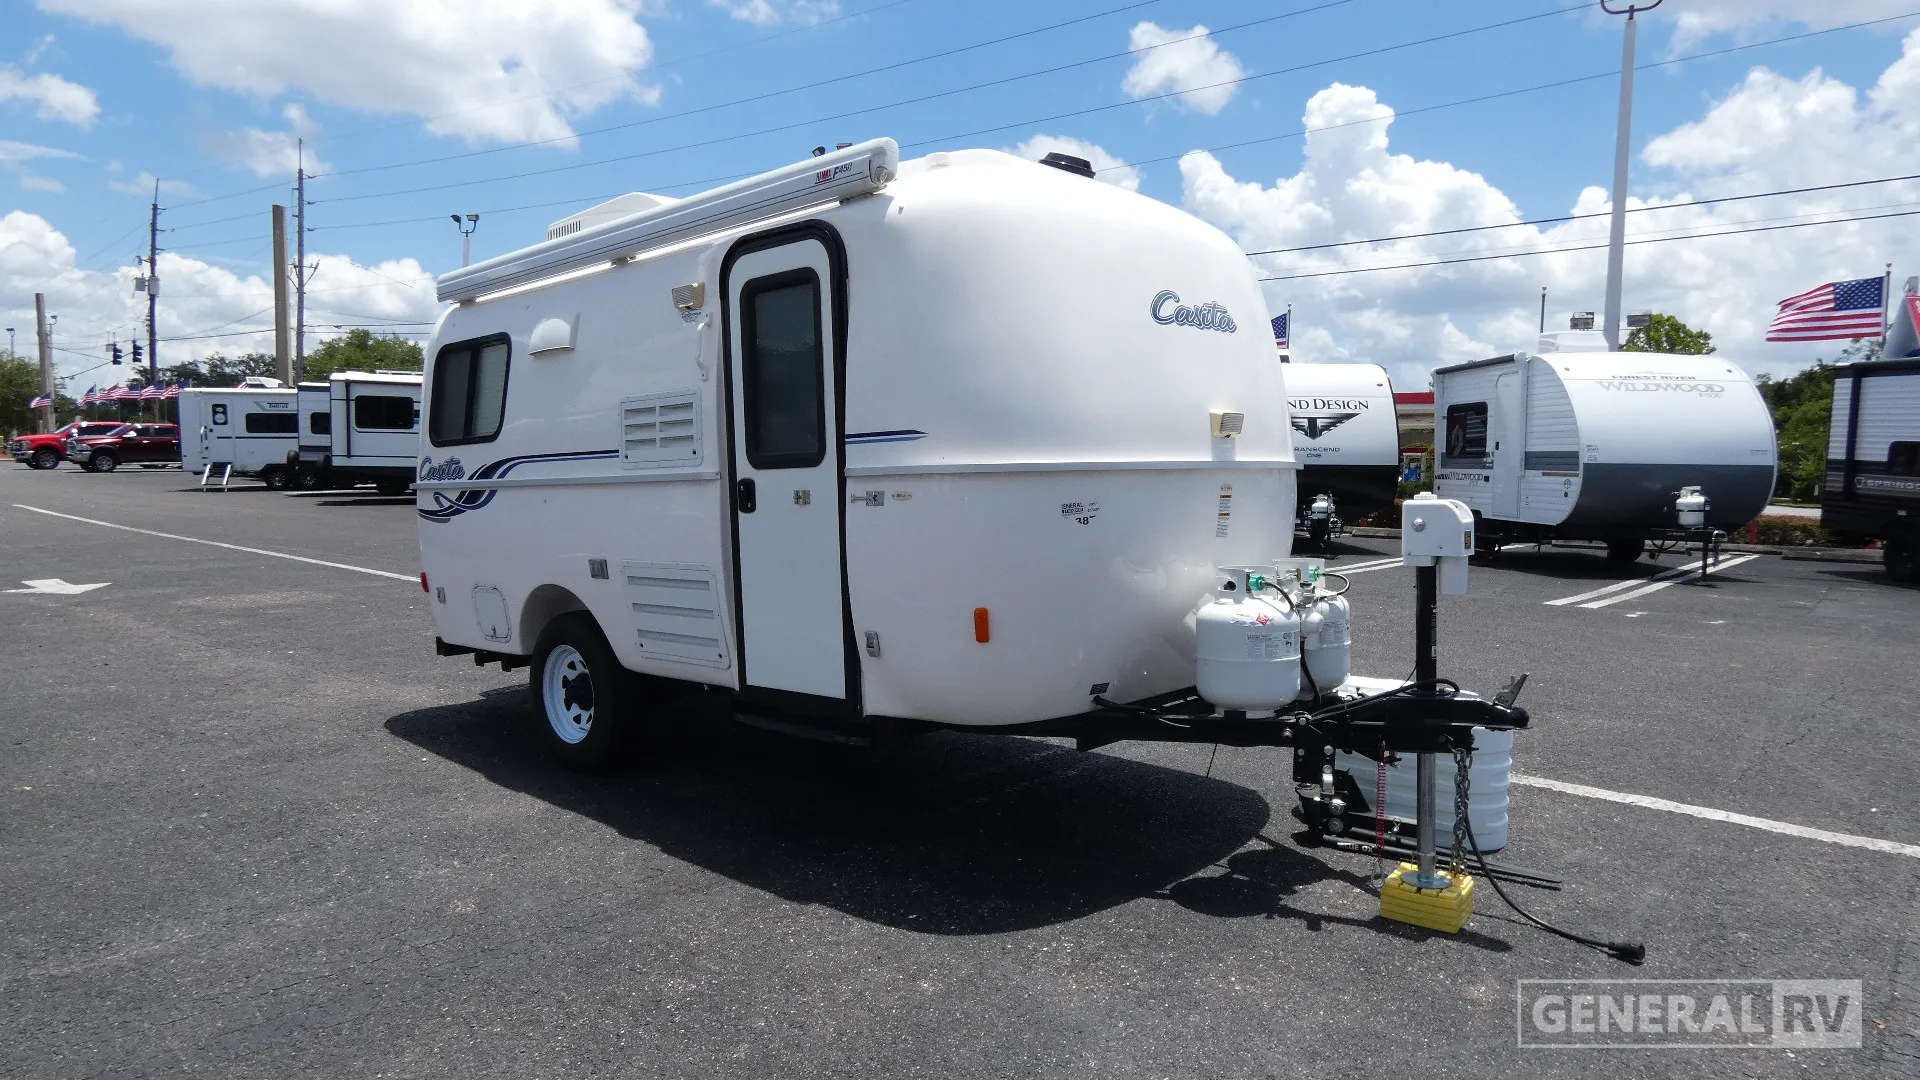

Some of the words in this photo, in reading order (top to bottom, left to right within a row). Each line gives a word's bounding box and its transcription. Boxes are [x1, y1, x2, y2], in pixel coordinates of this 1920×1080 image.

[1150, 289, 1237, 333] Casita
[1595, 380, 1725, 393] WILDWOOD
[420, 456, 466, 481] Casita
